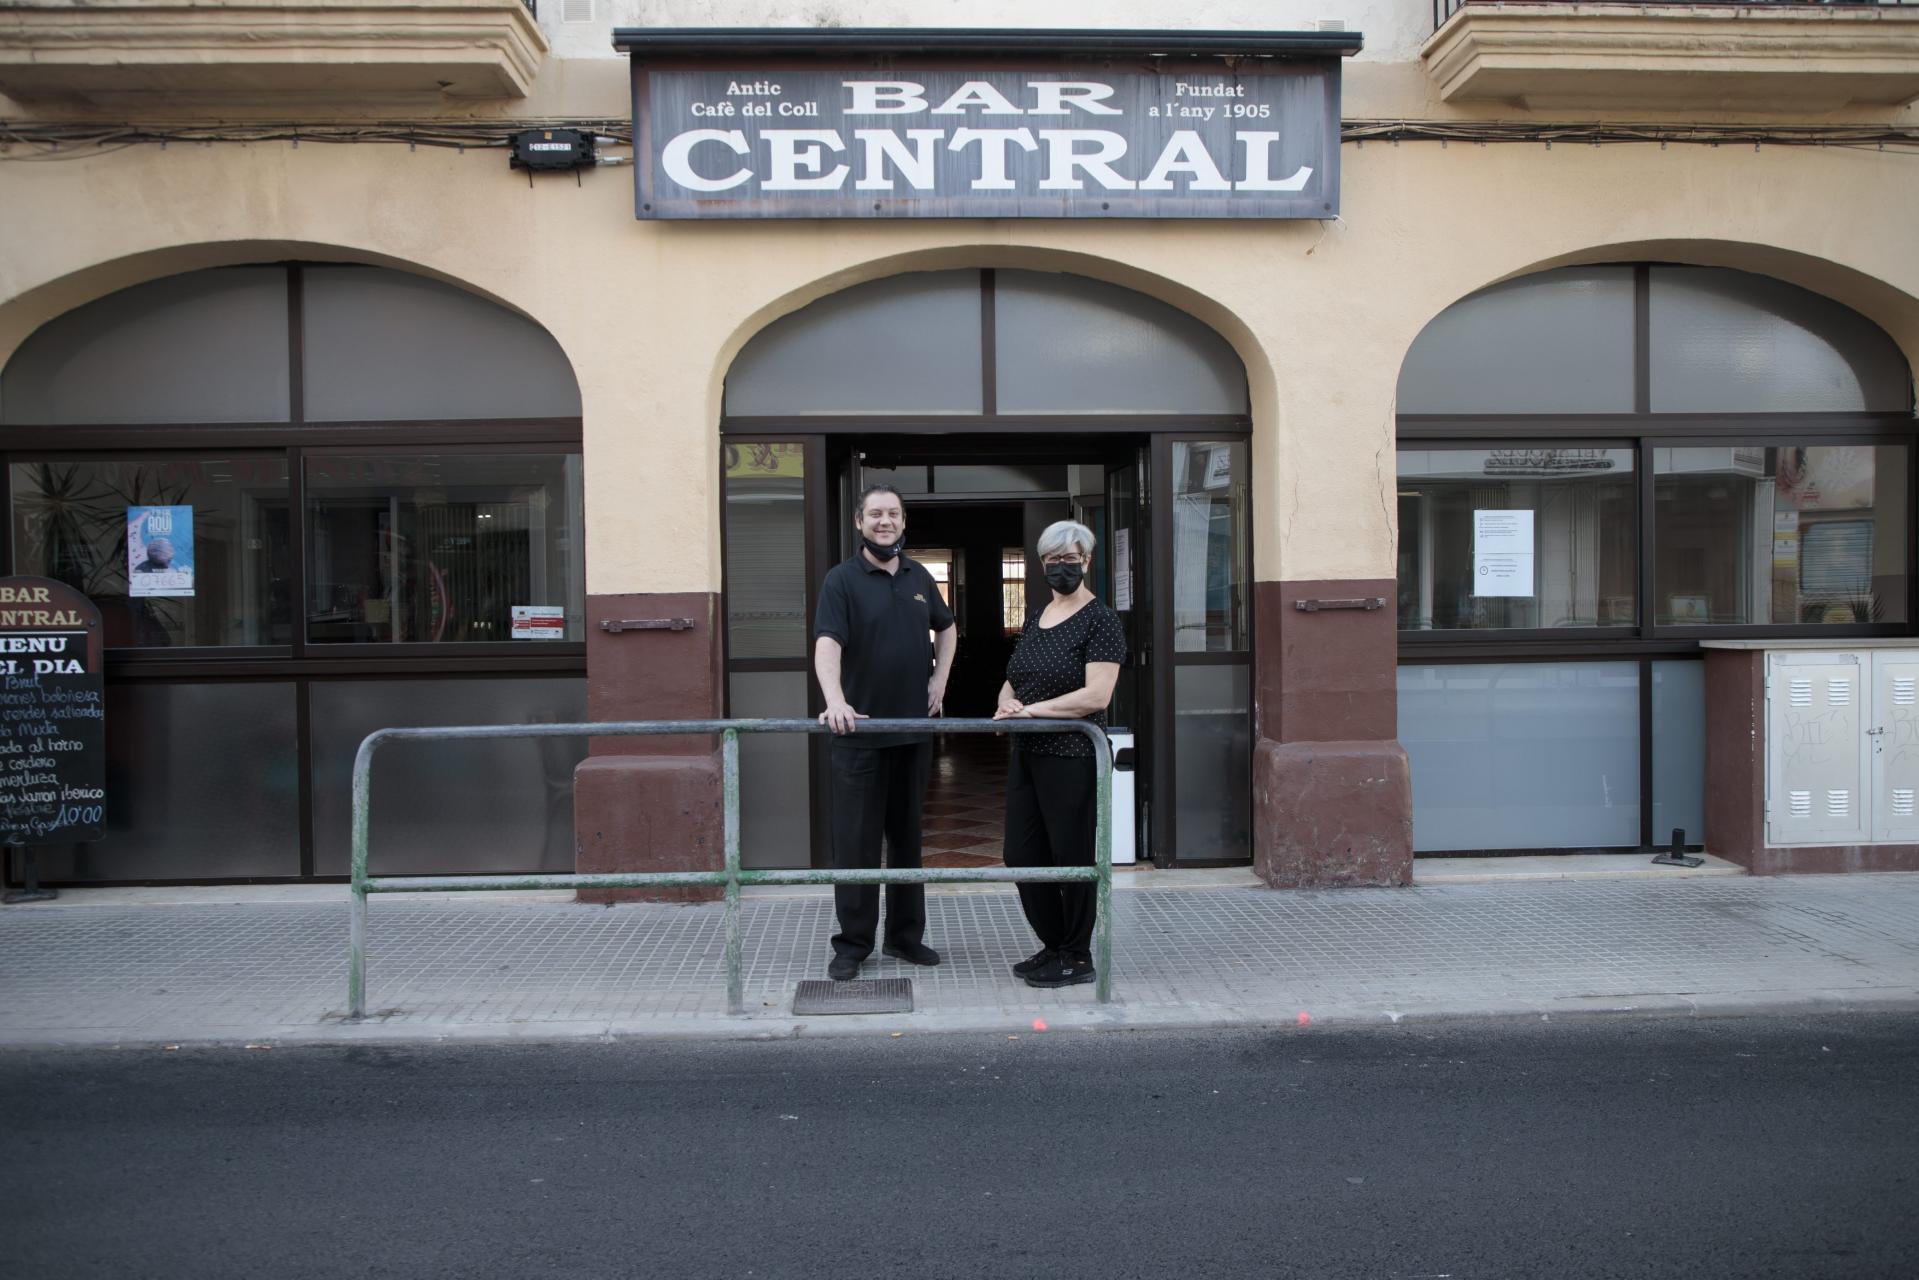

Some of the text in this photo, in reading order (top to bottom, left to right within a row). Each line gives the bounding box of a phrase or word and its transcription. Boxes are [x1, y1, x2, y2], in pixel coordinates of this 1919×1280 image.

[726, 80, 781, 96] Antic
[1175, 82, 1245, 98] Fundat
[842, 81, 1123, 115] BAR
[690, 101, 820, 117] Cafè del Coll
[1148, 105, 1161, 118] a
[1223, 103, 1271, 119] 1905
[661, 128, 1314, 192] CENTRAL
[0, 587, 51, 603] BAR
[33, 659, 85, 674] DIA
[28, 737, 44, 753] al
[48, 738, 84, 752] horno
